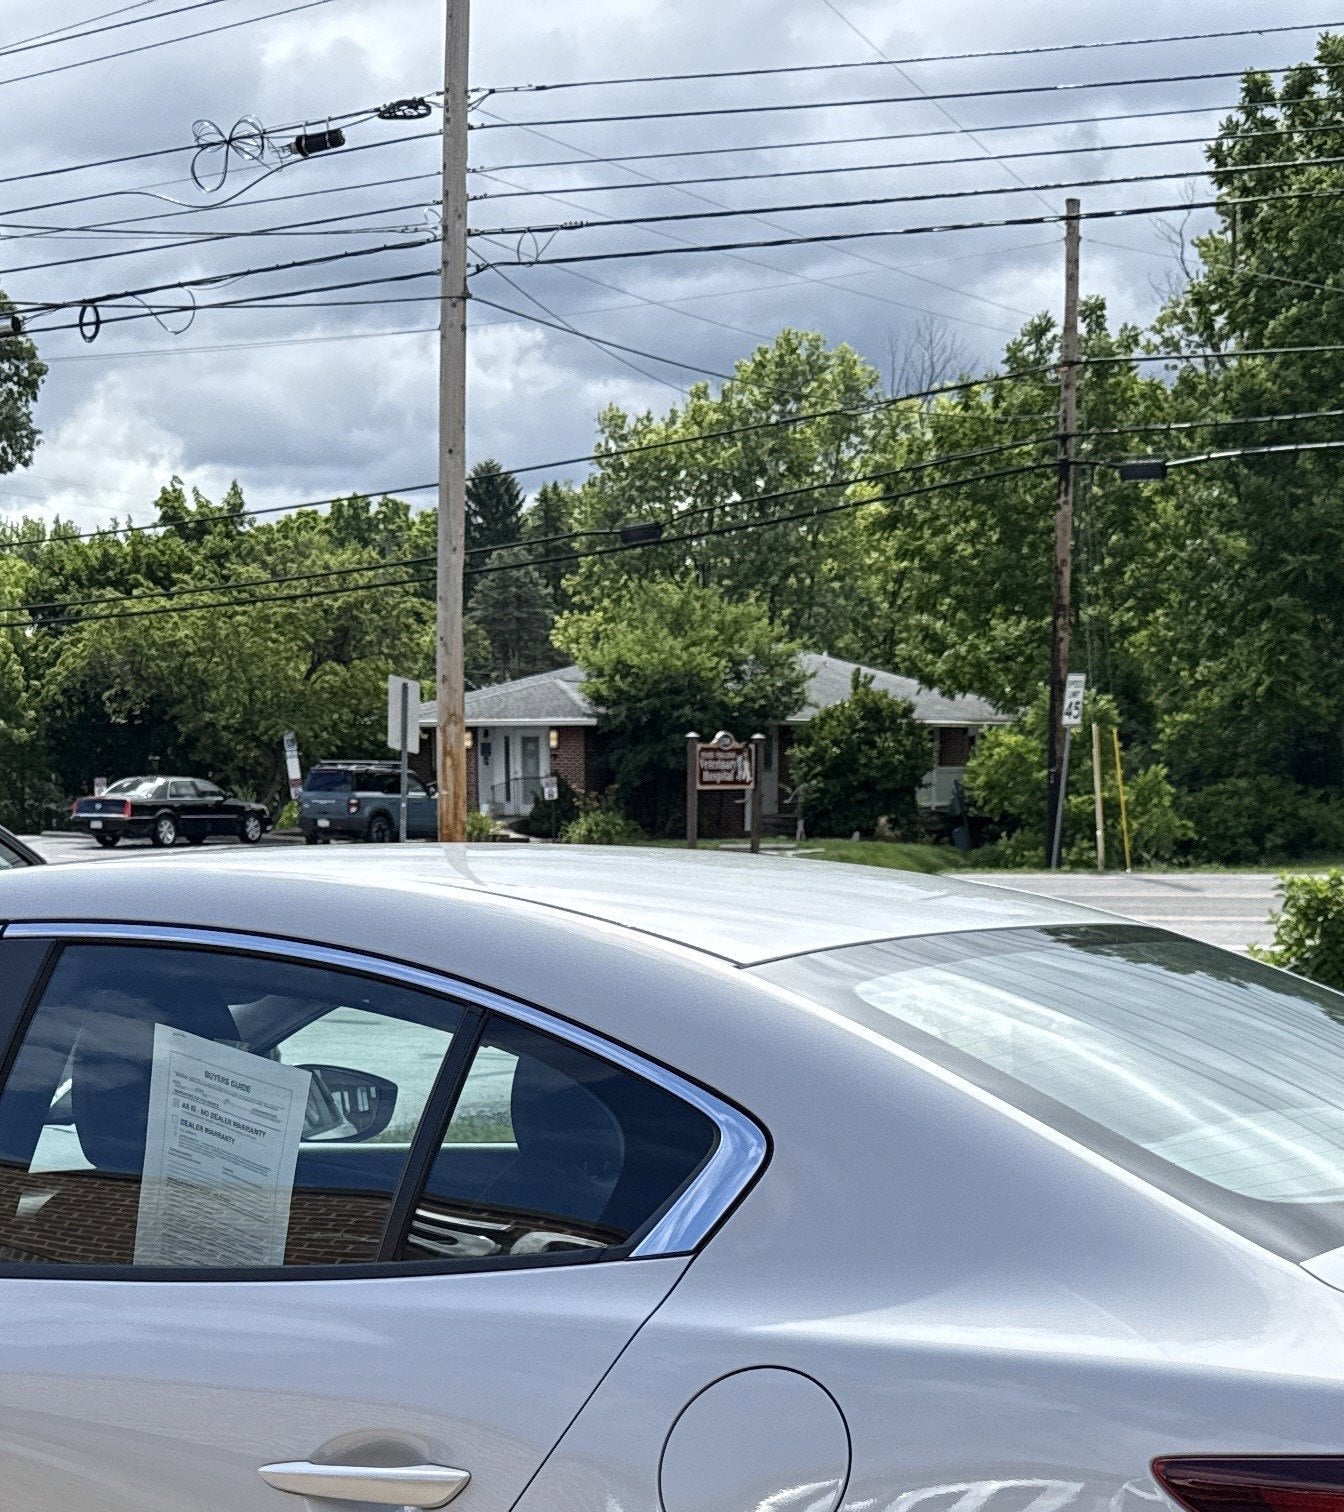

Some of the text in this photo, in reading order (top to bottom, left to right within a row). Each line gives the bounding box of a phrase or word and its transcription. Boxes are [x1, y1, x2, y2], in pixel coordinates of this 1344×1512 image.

[1064, 700, 1081, 720] 45
[230, 1080, 252, 1094] GUIDE
[180, 1118, 236, 1145] DEALER WARRANTY
[210, 1112, 232, 1126] DEALER
[232, 1121, 267, 1138] WARRANTY
